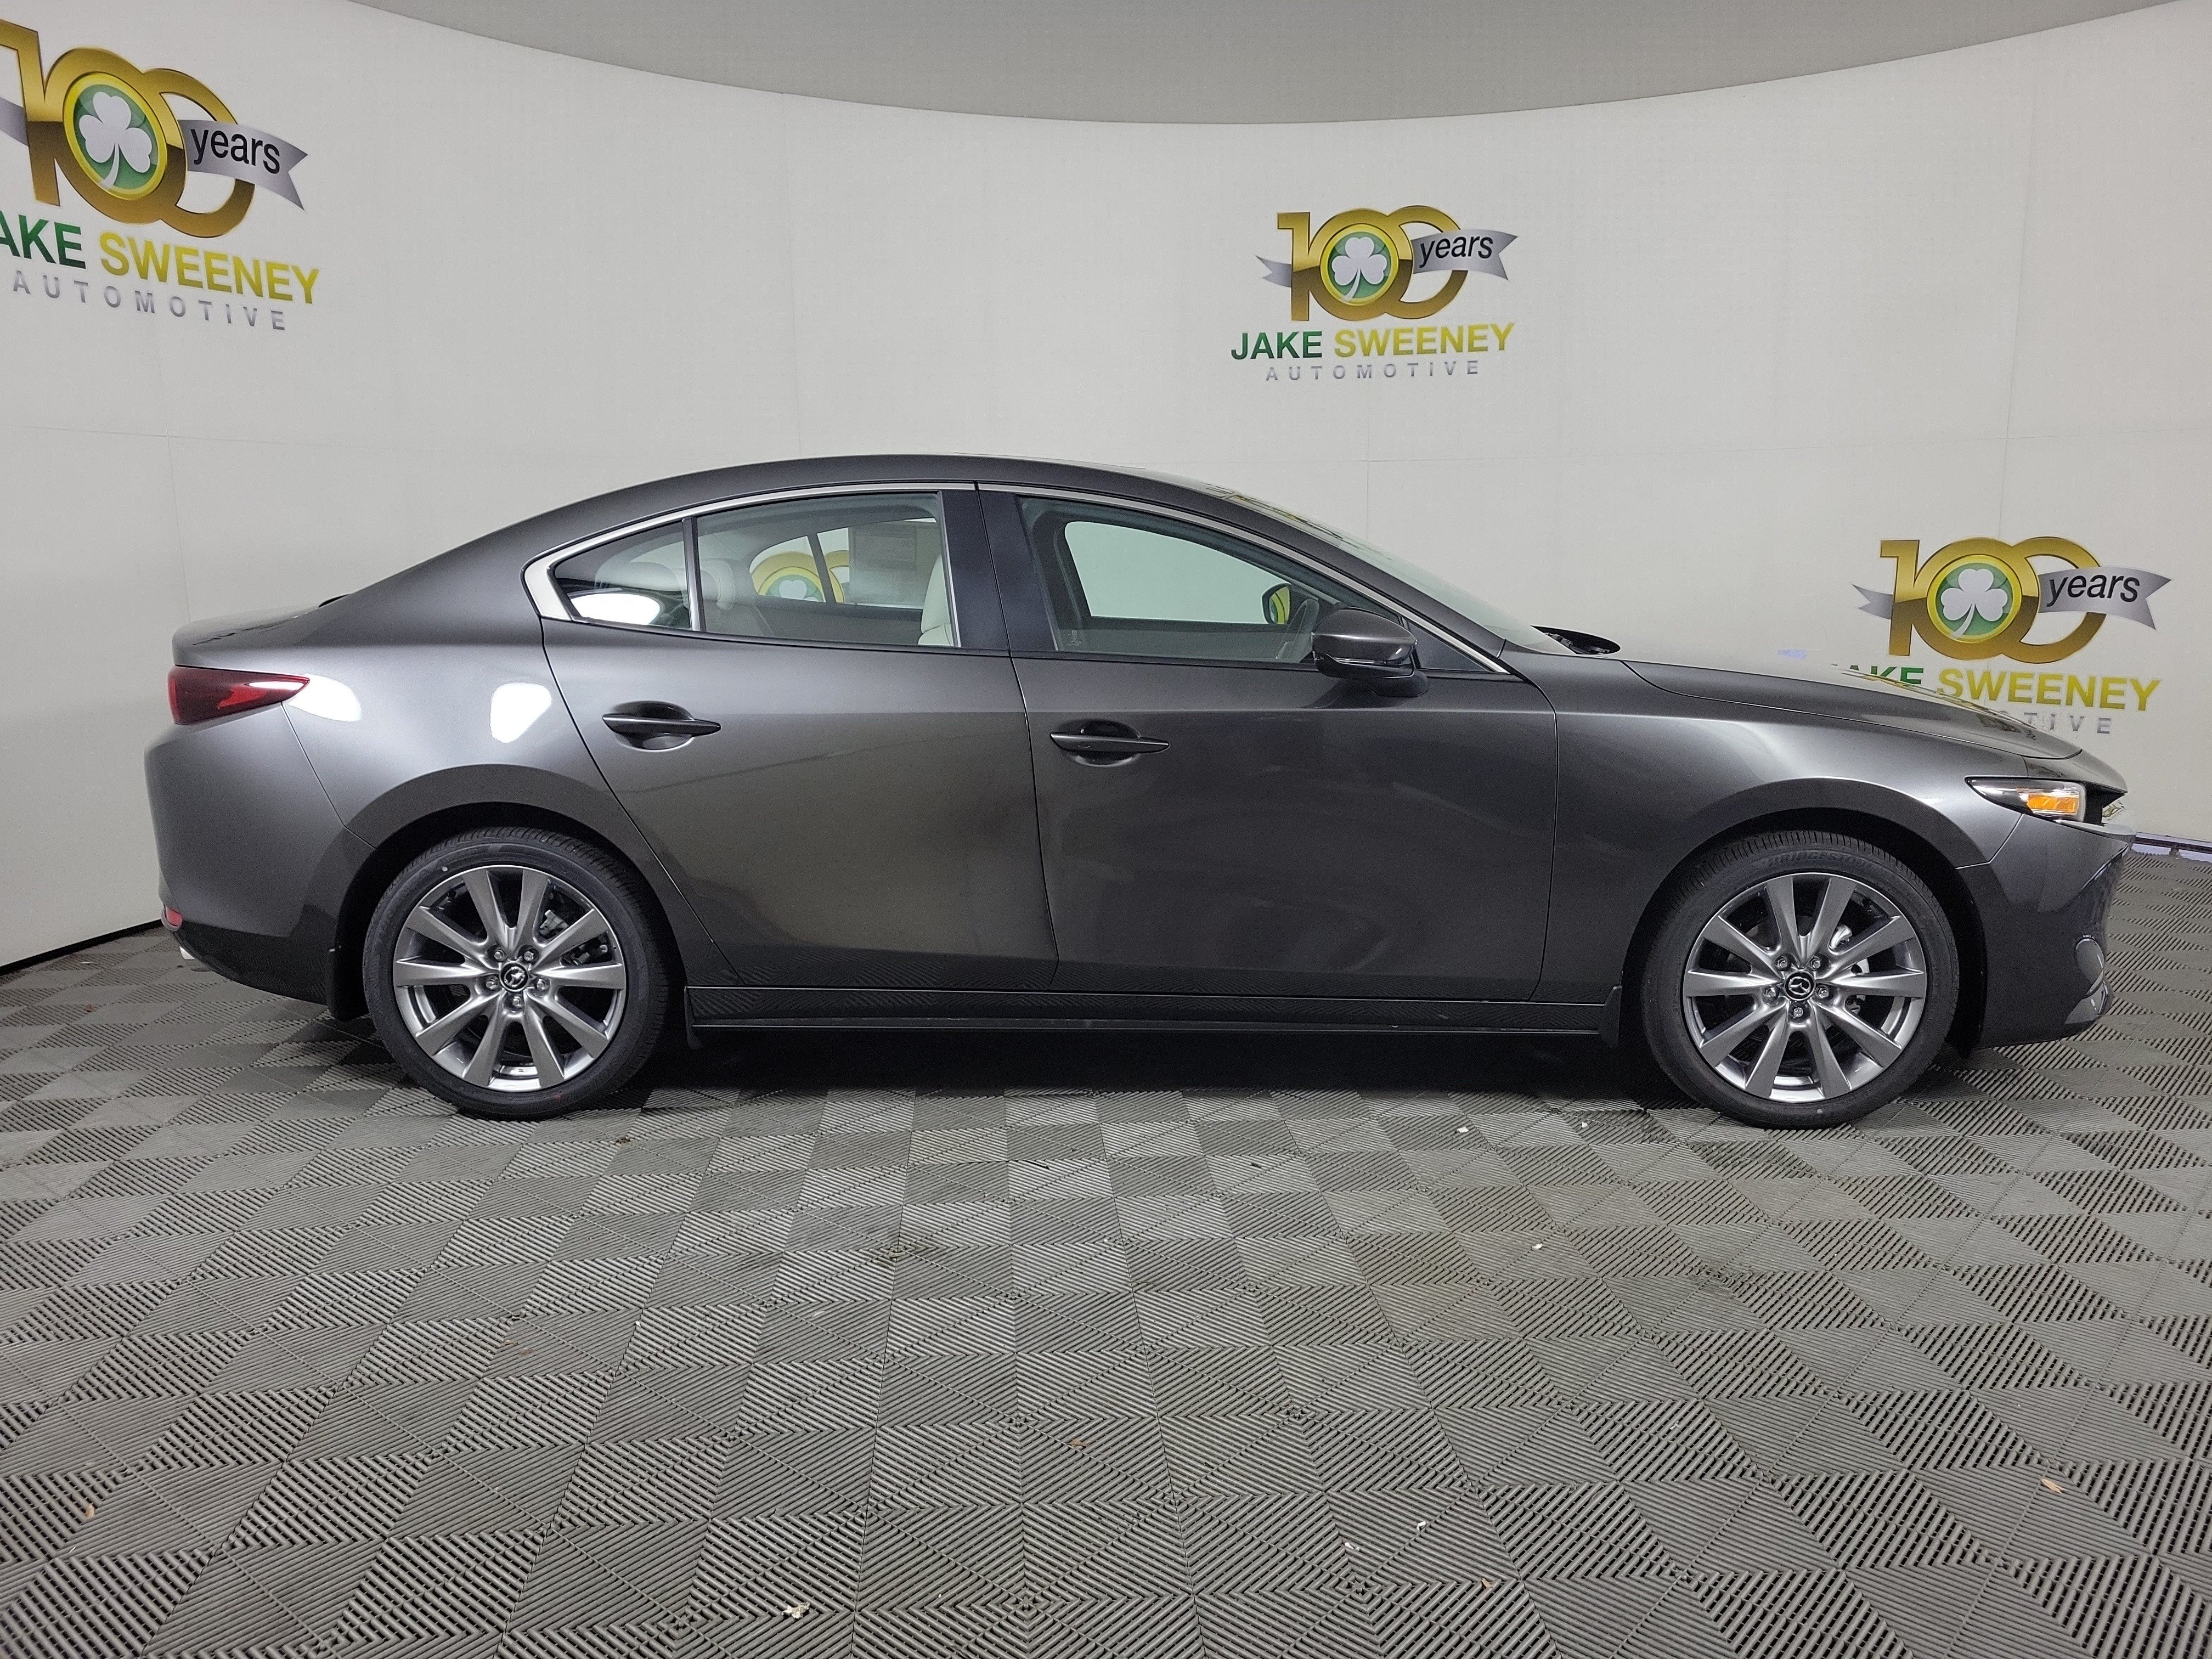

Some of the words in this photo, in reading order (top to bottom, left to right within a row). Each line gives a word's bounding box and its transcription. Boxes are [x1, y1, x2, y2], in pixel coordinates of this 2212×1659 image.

[190, 128, 280, 174] years
[0, 210, 86, 269] AKE
[99, 232, 319, 304] SWEENEY
[1277, 205, 1469, 321] 100
[1419, 236, 1493, 268] years
[13, 270, 285, 330] AUTOMOTIVE
[1231, 331, 1322, 359] JAKE
[1334, 323, 1515, 358] SWEENEY
[1266, 360, 1479, 381] AUTOMOTIVE
[1880, 536, 2108, 664] 100
[2046, 574, 2140, 607] years
[1937, 668, 2161, 710] SWEENEY
